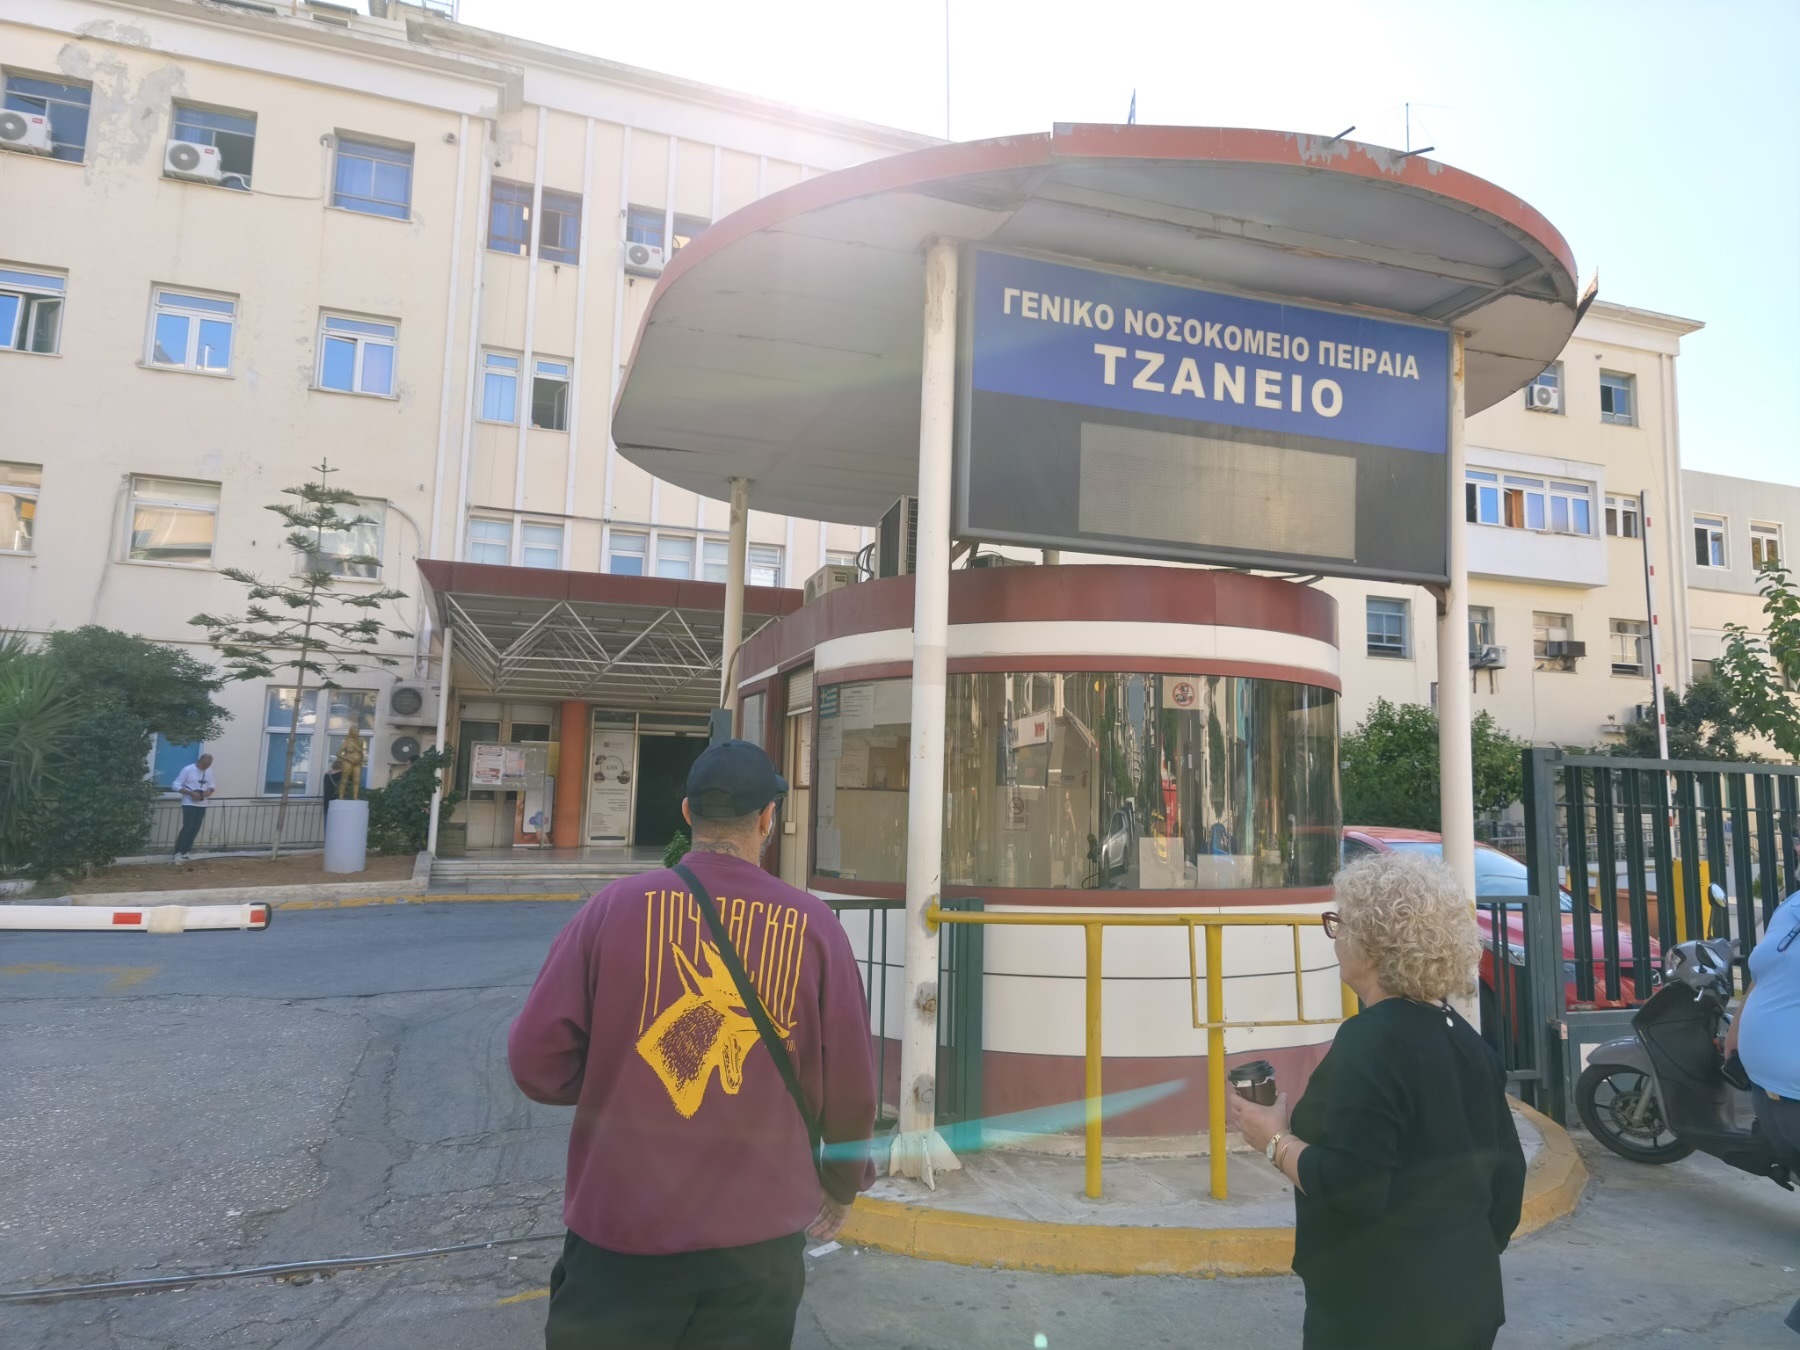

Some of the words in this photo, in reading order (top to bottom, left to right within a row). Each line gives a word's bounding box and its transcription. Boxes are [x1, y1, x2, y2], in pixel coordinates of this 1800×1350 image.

[1002, 287, 1114, 331] ΓΕΝΙΚΟ
[1124, 308, 1310, 362] ΝΟΣΟΚΟΜΕΙΟ
[1318, 341, 1420, 380] ΠΕΙΡΑΙΑ
[1093, 343, 1344, 418] ΤΖΑΝΕΙΟ
[638, 890, 702, 1036] TINY
